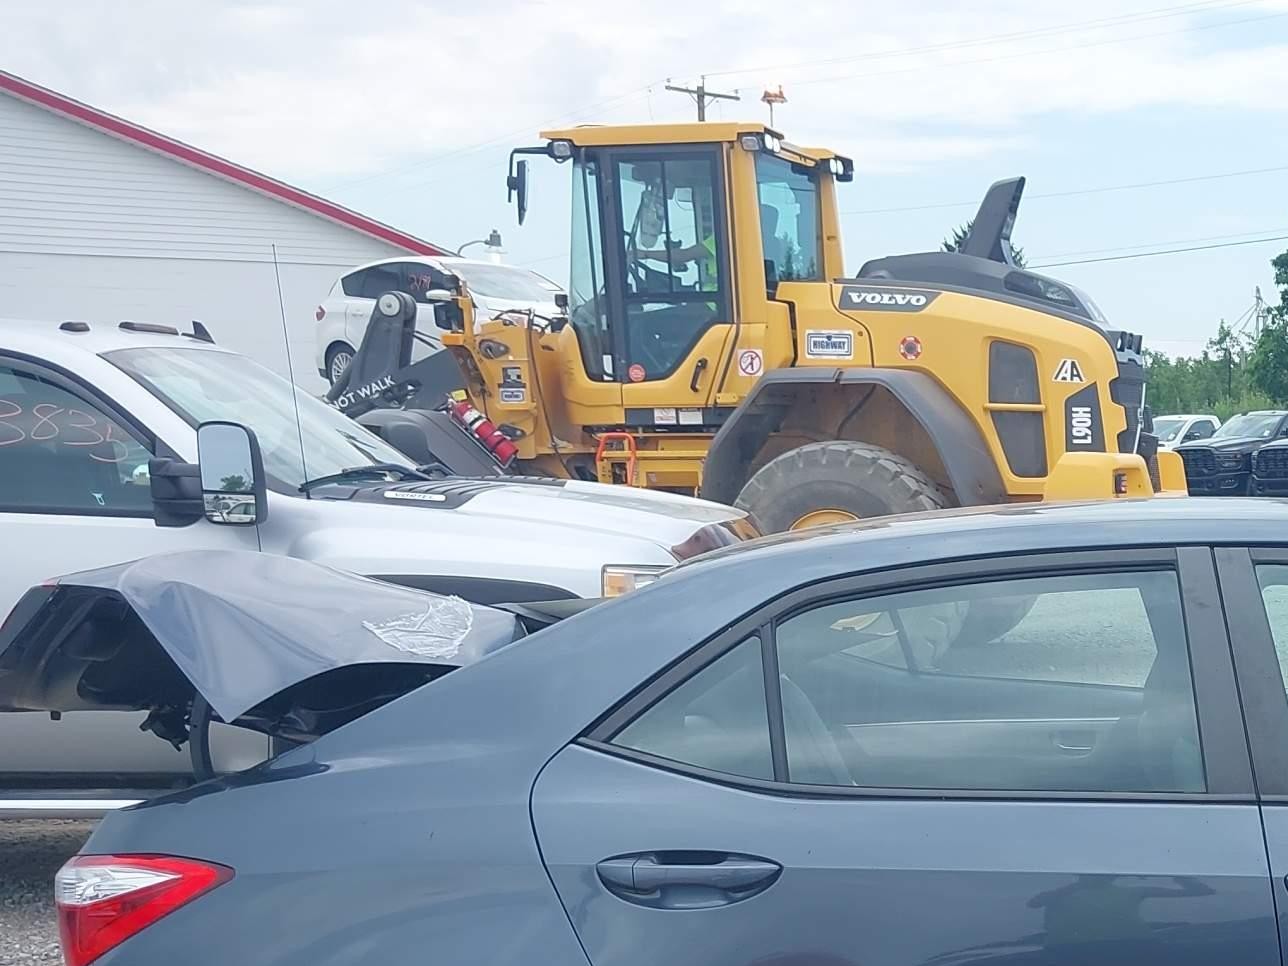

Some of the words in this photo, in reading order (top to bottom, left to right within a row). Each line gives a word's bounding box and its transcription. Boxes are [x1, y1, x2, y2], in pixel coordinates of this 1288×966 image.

[848, 292, 927, 306] VOLVO
[812, 341, 846, 350] HIGHWAY
[357, 375, 396, 399] WALK
[1071, 407, 1092, 444] L90H
